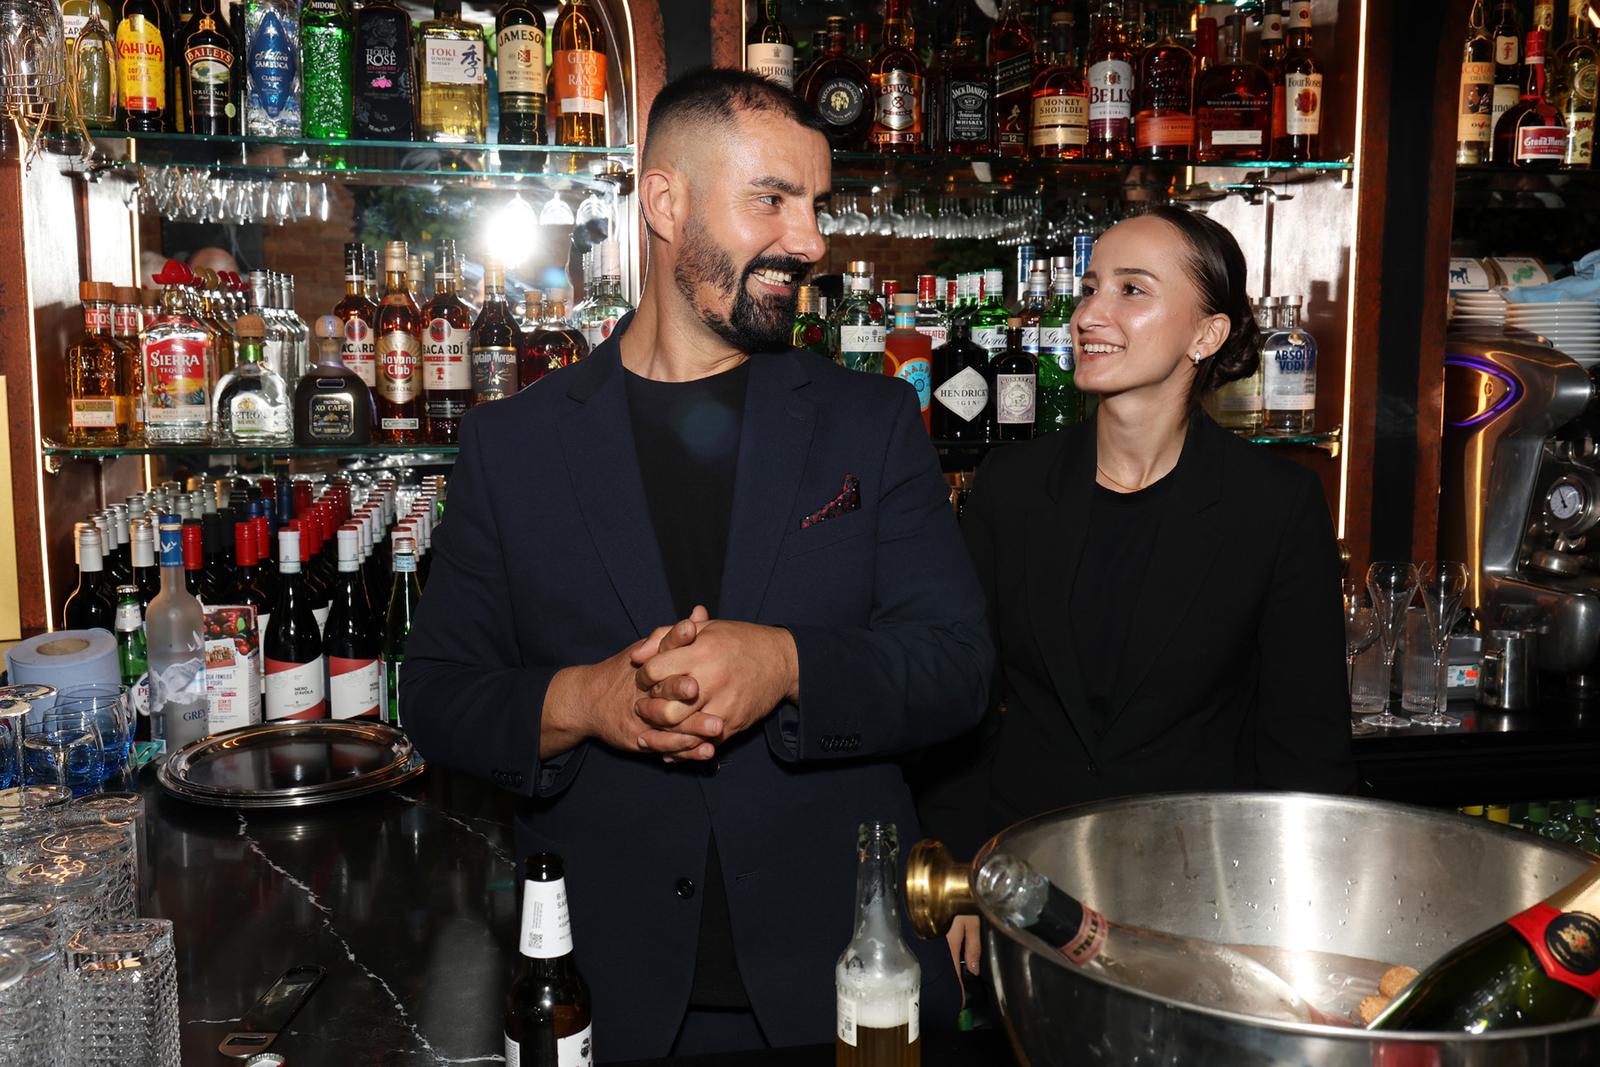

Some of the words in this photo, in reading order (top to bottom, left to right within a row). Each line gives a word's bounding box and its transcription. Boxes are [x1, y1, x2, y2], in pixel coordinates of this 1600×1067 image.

[187, 48, 231, 62] BAILEYS
[366, 48, 396, 56] TEQUILA
[567, 52, 597, 63] GLEN
[255, 61, 288, 69] SAMBUCA
[366, 55, 397, 67] ROSE
[576, 64, 597, 75] MO
[568, 74, 591, 85] RAN
[881, 85, 915, 95] CHIVAS
[952, 88, 965, 99] JACK
[1089, 86, 1132, 104] BELL'S
[1043, 98, 1081, 106] MONKEY
[906, 134, 914, 142] 12
[1009, 134, 1017, 142] 12
[150, 349, 201, 368] SIERRA
[381, 353, 416, 364] Havana
[492, 351, 516, 364] Morgan
[387, 364, 410, 375] Club
